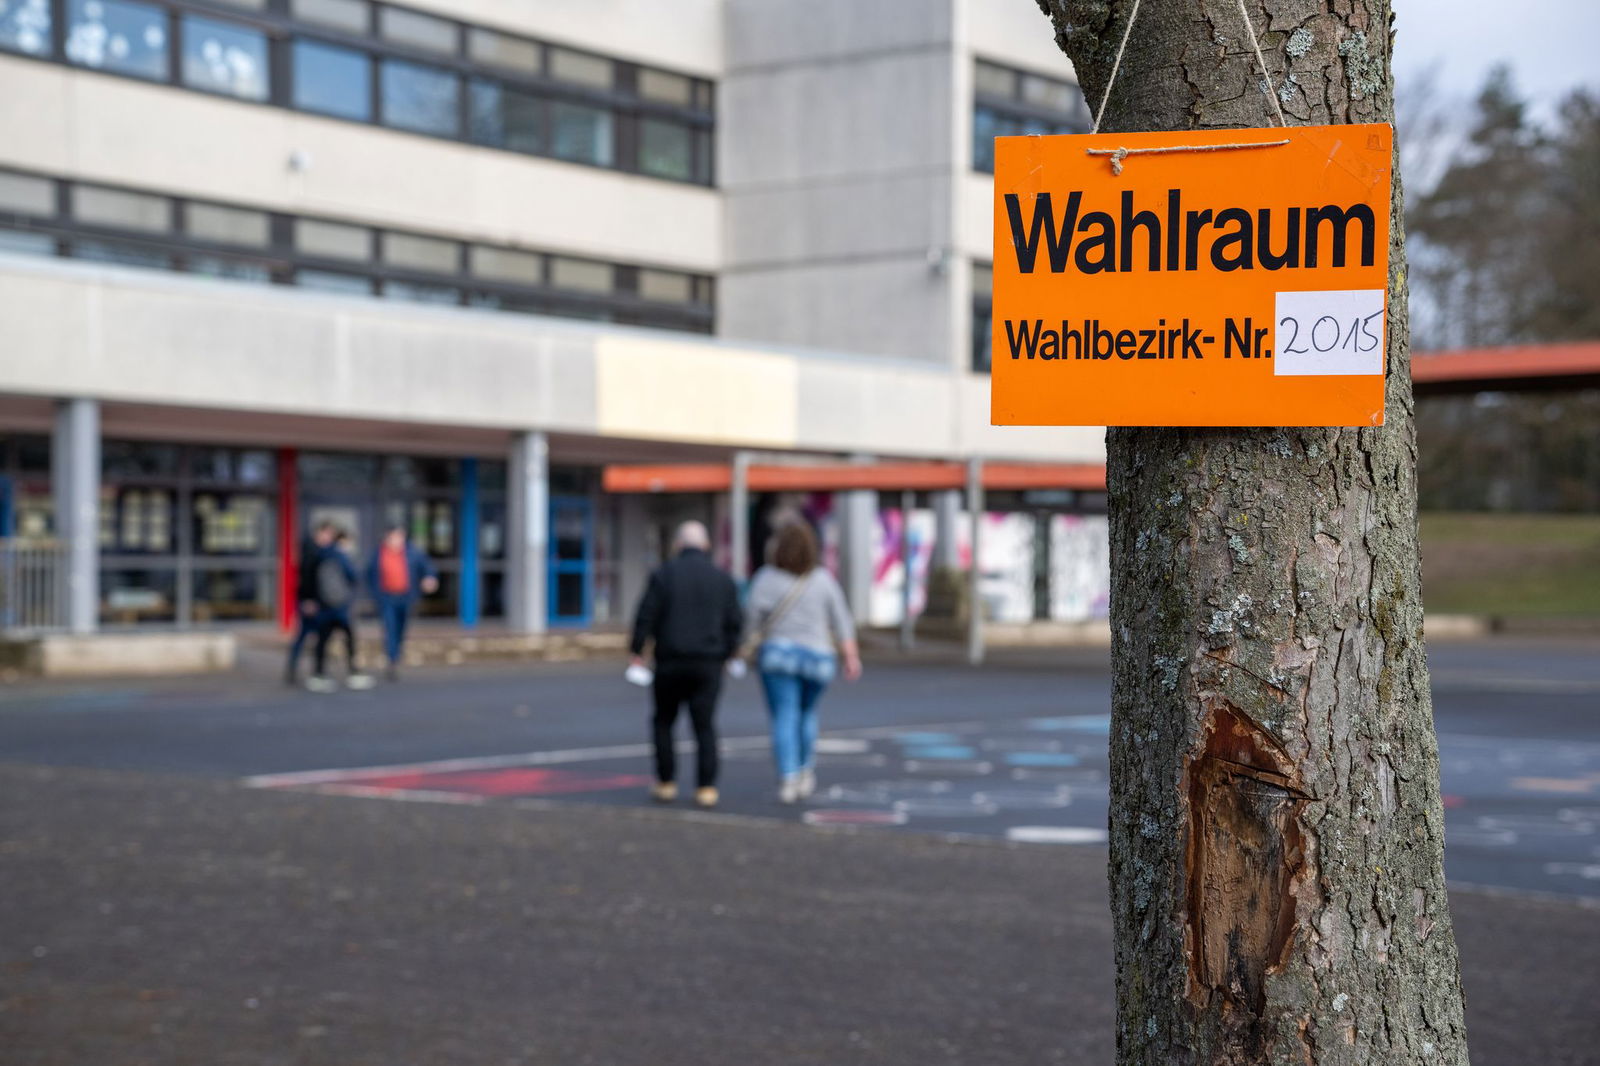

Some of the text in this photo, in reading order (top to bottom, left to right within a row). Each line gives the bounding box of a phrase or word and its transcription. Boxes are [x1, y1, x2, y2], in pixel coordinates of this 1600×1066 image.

[1004, 189, 1375, 274] Wahlraum
[1005, 318, 1272, 361] Wahlbezirk- Nr.
[1279, 309, 1385, 353] 2015
